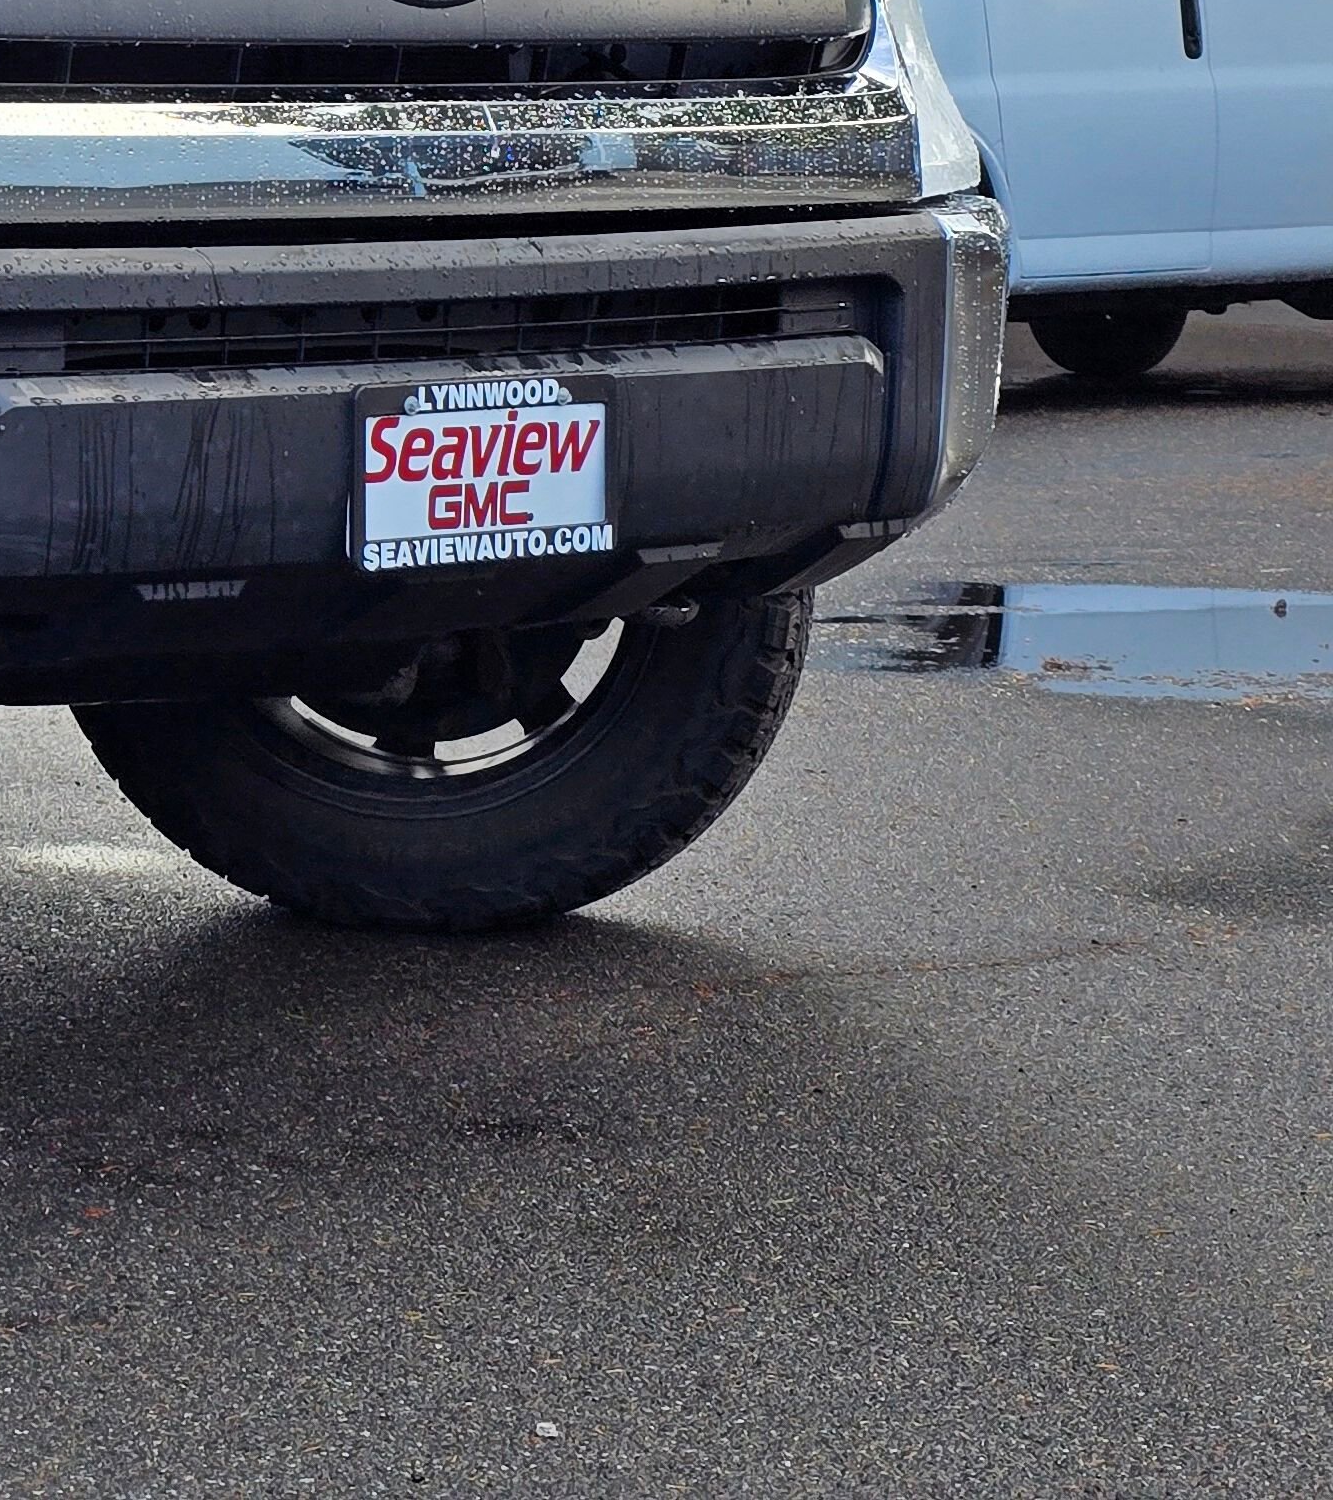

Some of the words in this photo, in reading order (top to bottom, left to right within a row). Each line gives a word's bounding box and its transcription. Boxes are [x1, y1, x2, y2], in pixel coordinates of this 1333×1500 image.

[417, 378, 560, 412] LYNNWOOD
[363, 409, 600, 483] Seaview
[428, 479, 534, 530] GMC
[363, 524, 614, 572] SEAVIEWAUTO.COM
